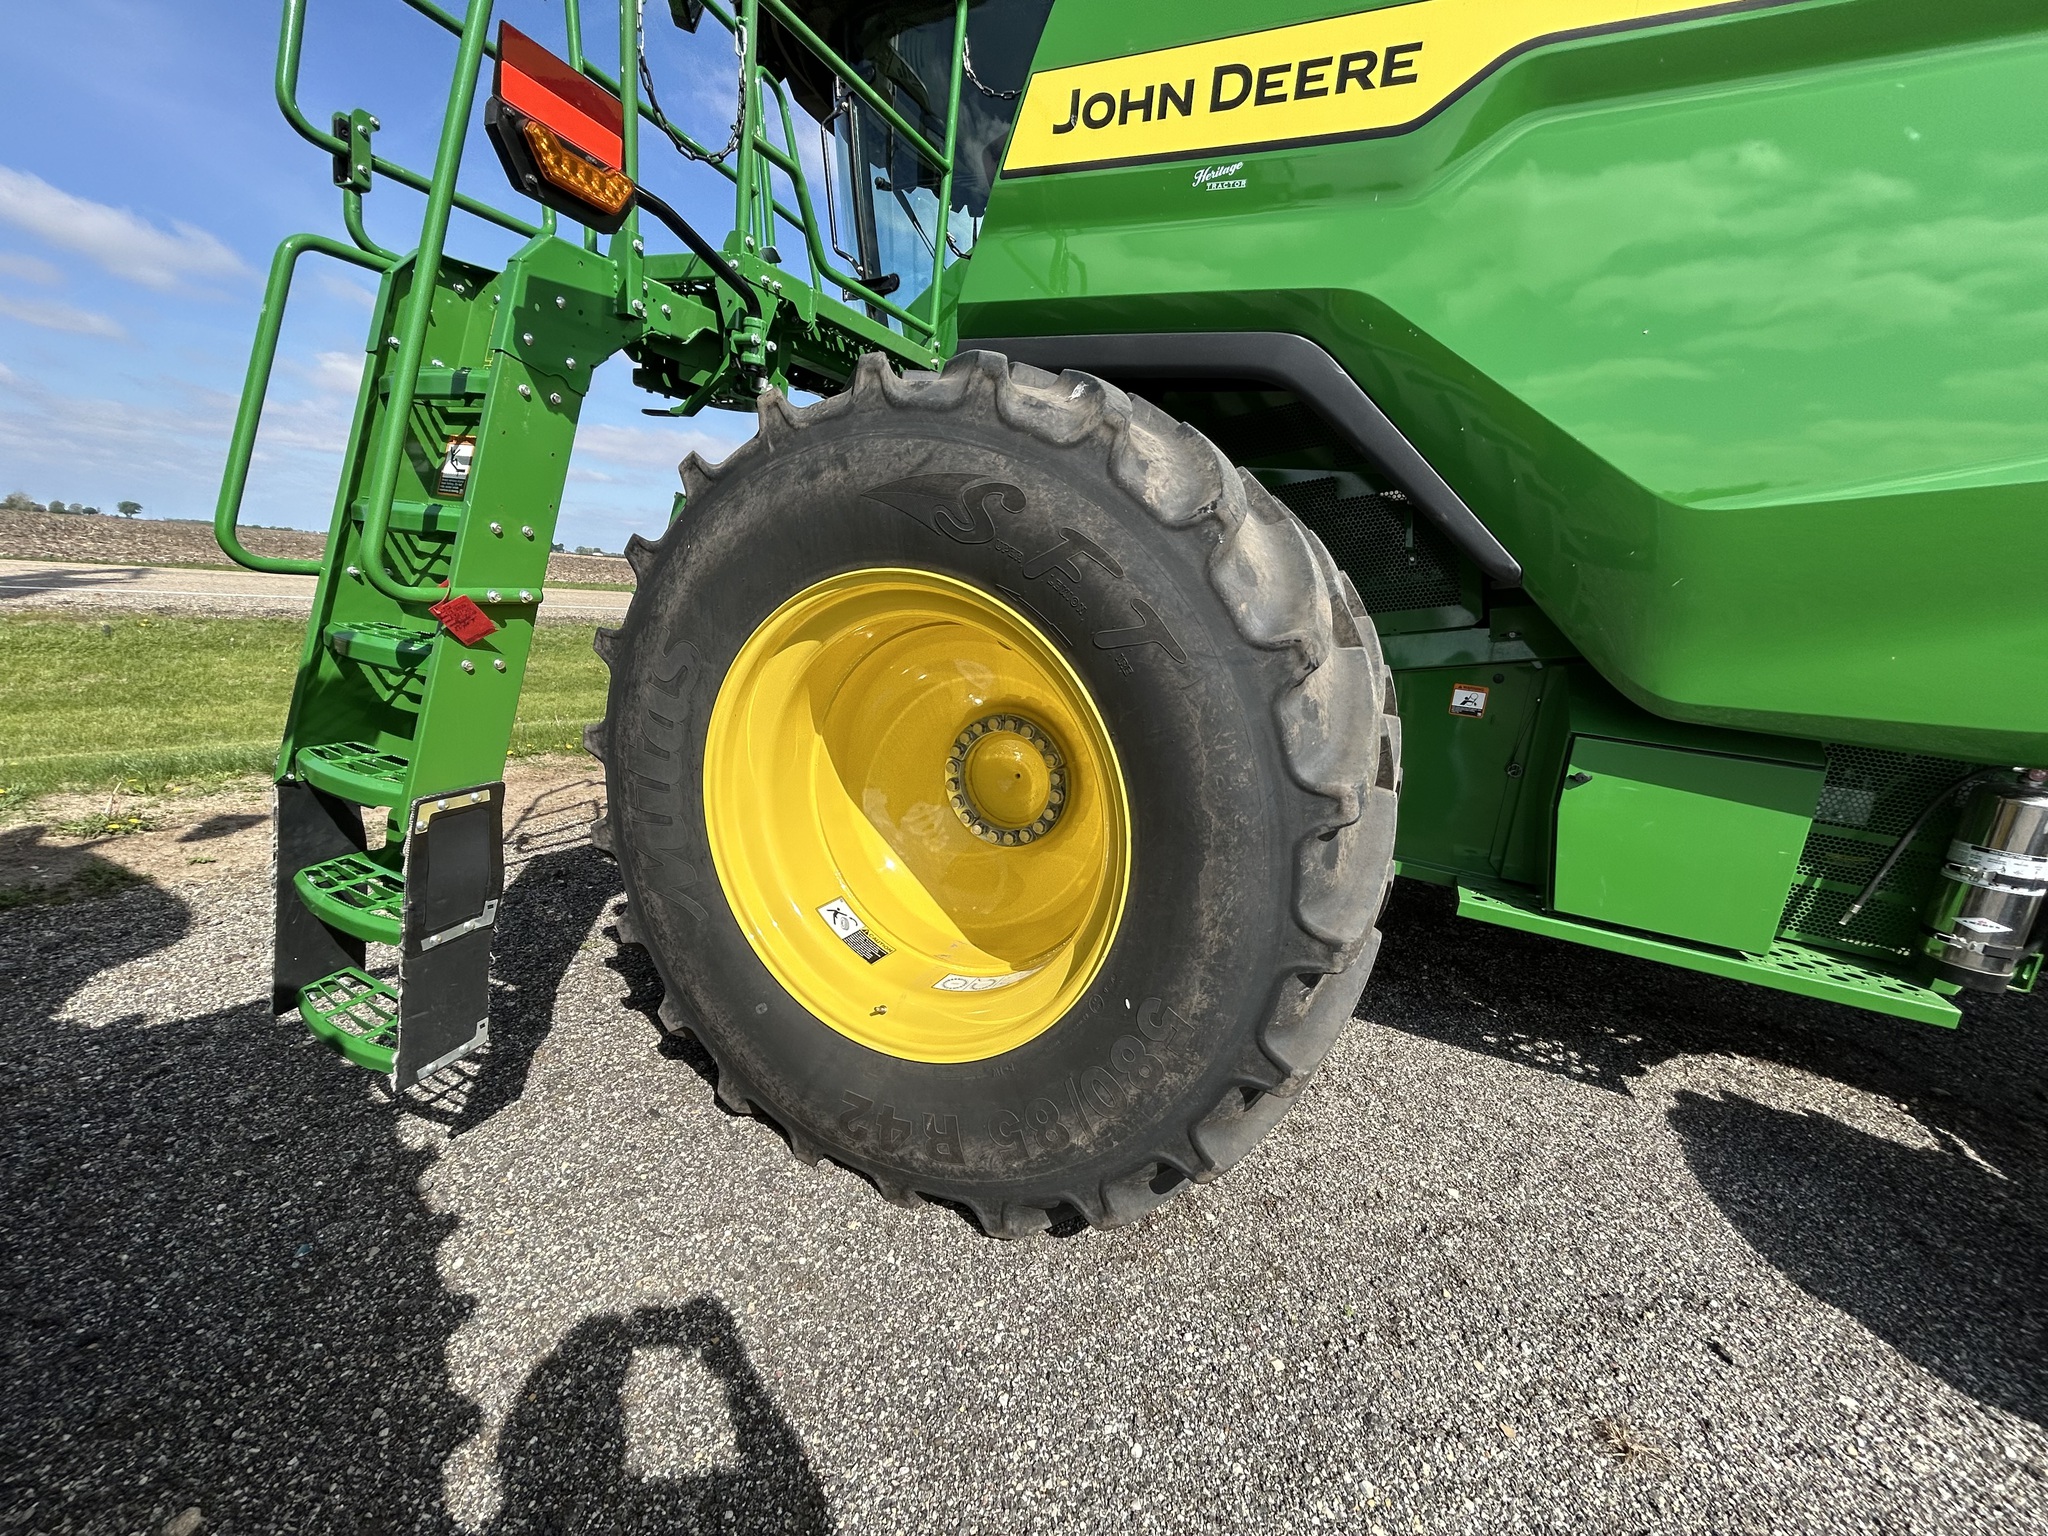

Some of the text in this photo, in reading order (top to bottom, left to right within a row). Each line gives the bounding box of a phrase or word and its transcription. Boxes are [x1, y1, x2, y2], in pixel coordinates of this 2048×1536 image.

[1053, 42, 1423, 134] JOHN DEERE
[1192, 161, 1244, 187] Heritage
[1206, 179, 1246, 191] TRACTOR
[868, 933, 893, 953] CAUTION
[987, 996, 1199, 1163] 580/85
